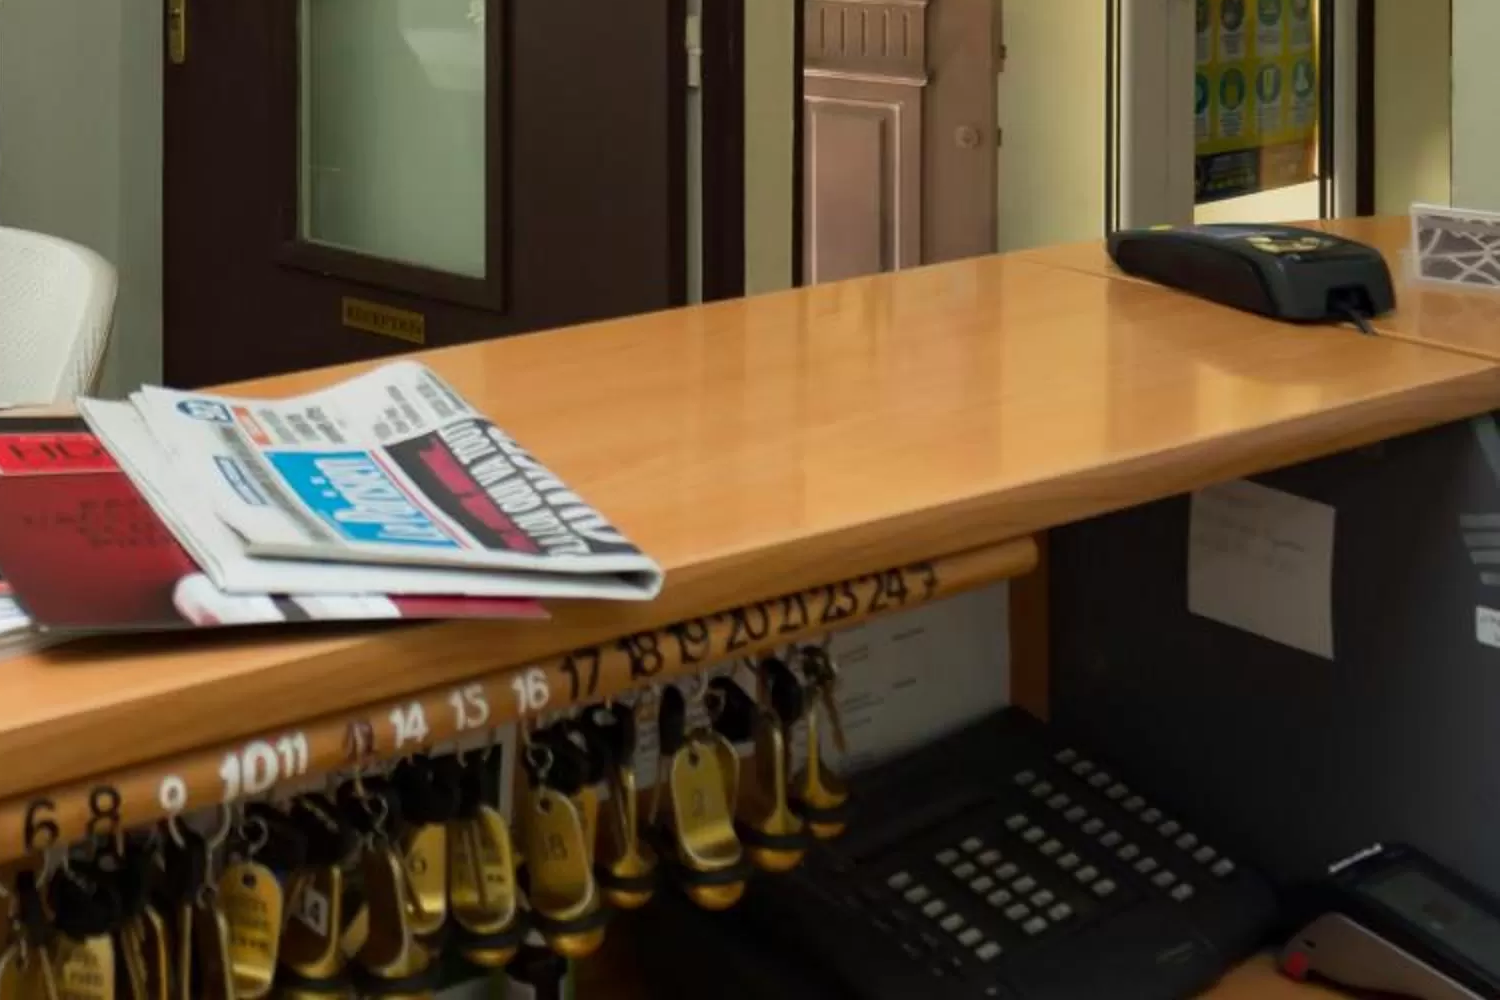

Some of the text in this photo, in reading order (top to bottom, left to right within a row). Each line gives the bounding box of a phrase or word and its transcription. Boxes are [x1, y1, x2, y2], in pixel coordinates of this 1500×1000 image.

[22, 799, 59, 850] 6
[220, 740, 279, 802] 10
[389, 701, 429, 748] 14
[449, 683, 490, 731] 15
[512, 666, 550, 714] 16
[561, 650, 600, 701] 17
[618, 631, 664, 681] 18
[666, 617, 711, 664] 19
[722, 603, 770, 652] 20
